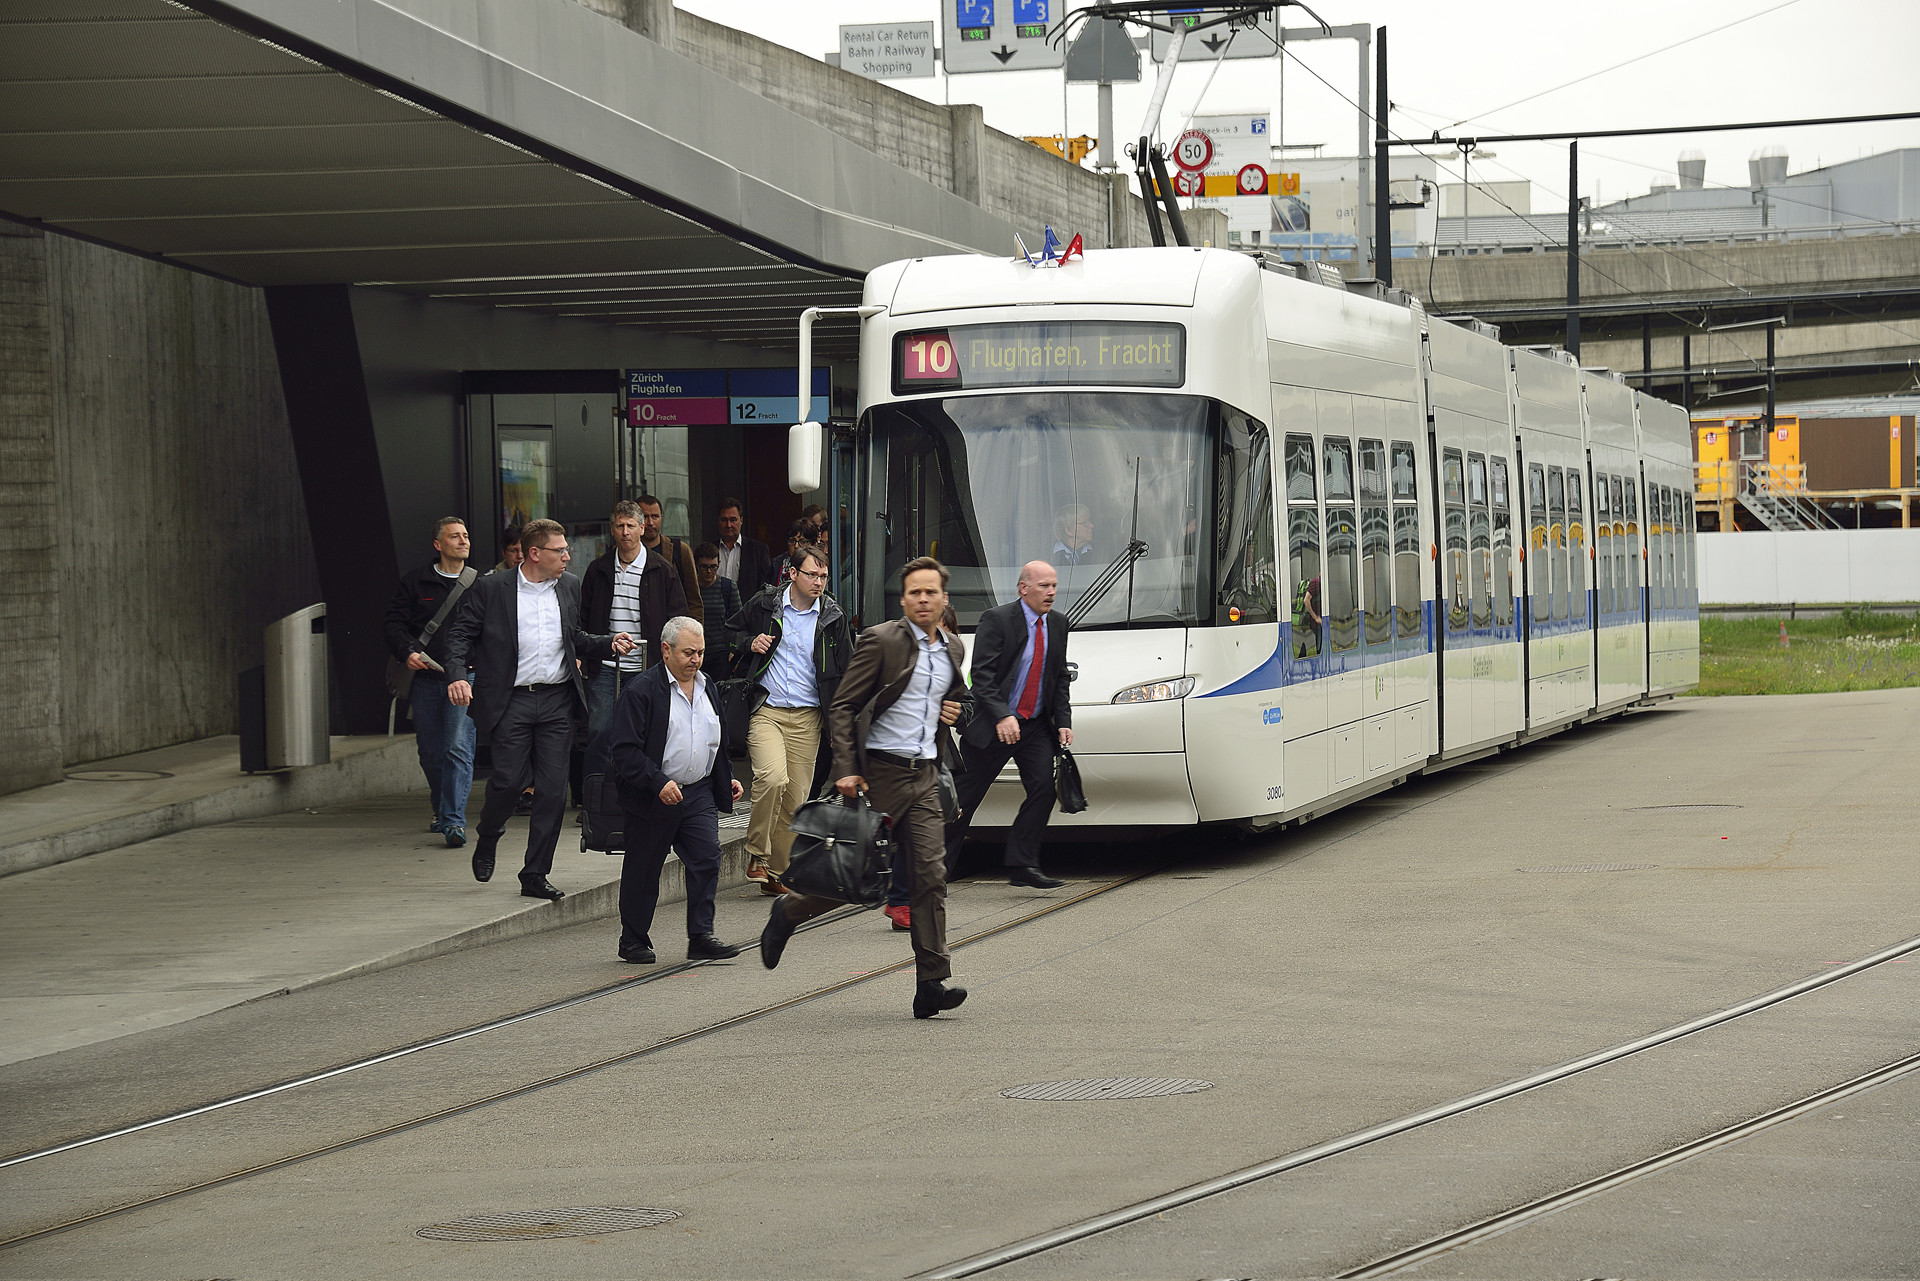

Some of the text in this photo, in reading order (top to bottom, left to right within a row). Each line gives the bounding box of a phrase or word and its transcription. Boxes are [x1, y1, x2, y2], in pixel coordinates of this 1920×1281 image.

[981, 6, 990, 24] 2
[1036, 3, 1046, 20] 3
[844, 29, 929, 43] Rental Car Return
[848, 46, 874, 58] Bahn
[885, 45, 926, 58] Railway
[863, 61, 912, 75] Shopping
[1185, 144, 1201, 159] 50
[1246, 175, 1252, 185] 2
[1336, 208, 1354, 219] gat
[911, 336, 1172, 373] 10 Flughafen, Fracht
[631, 373, 664, 383] Zürich
[631, 384, 682, 395] Flughafen
[633, 404, 655, 421] 10
[736, 403, 756, 419] 12
[1267, 785, 1282, 800] 3080
